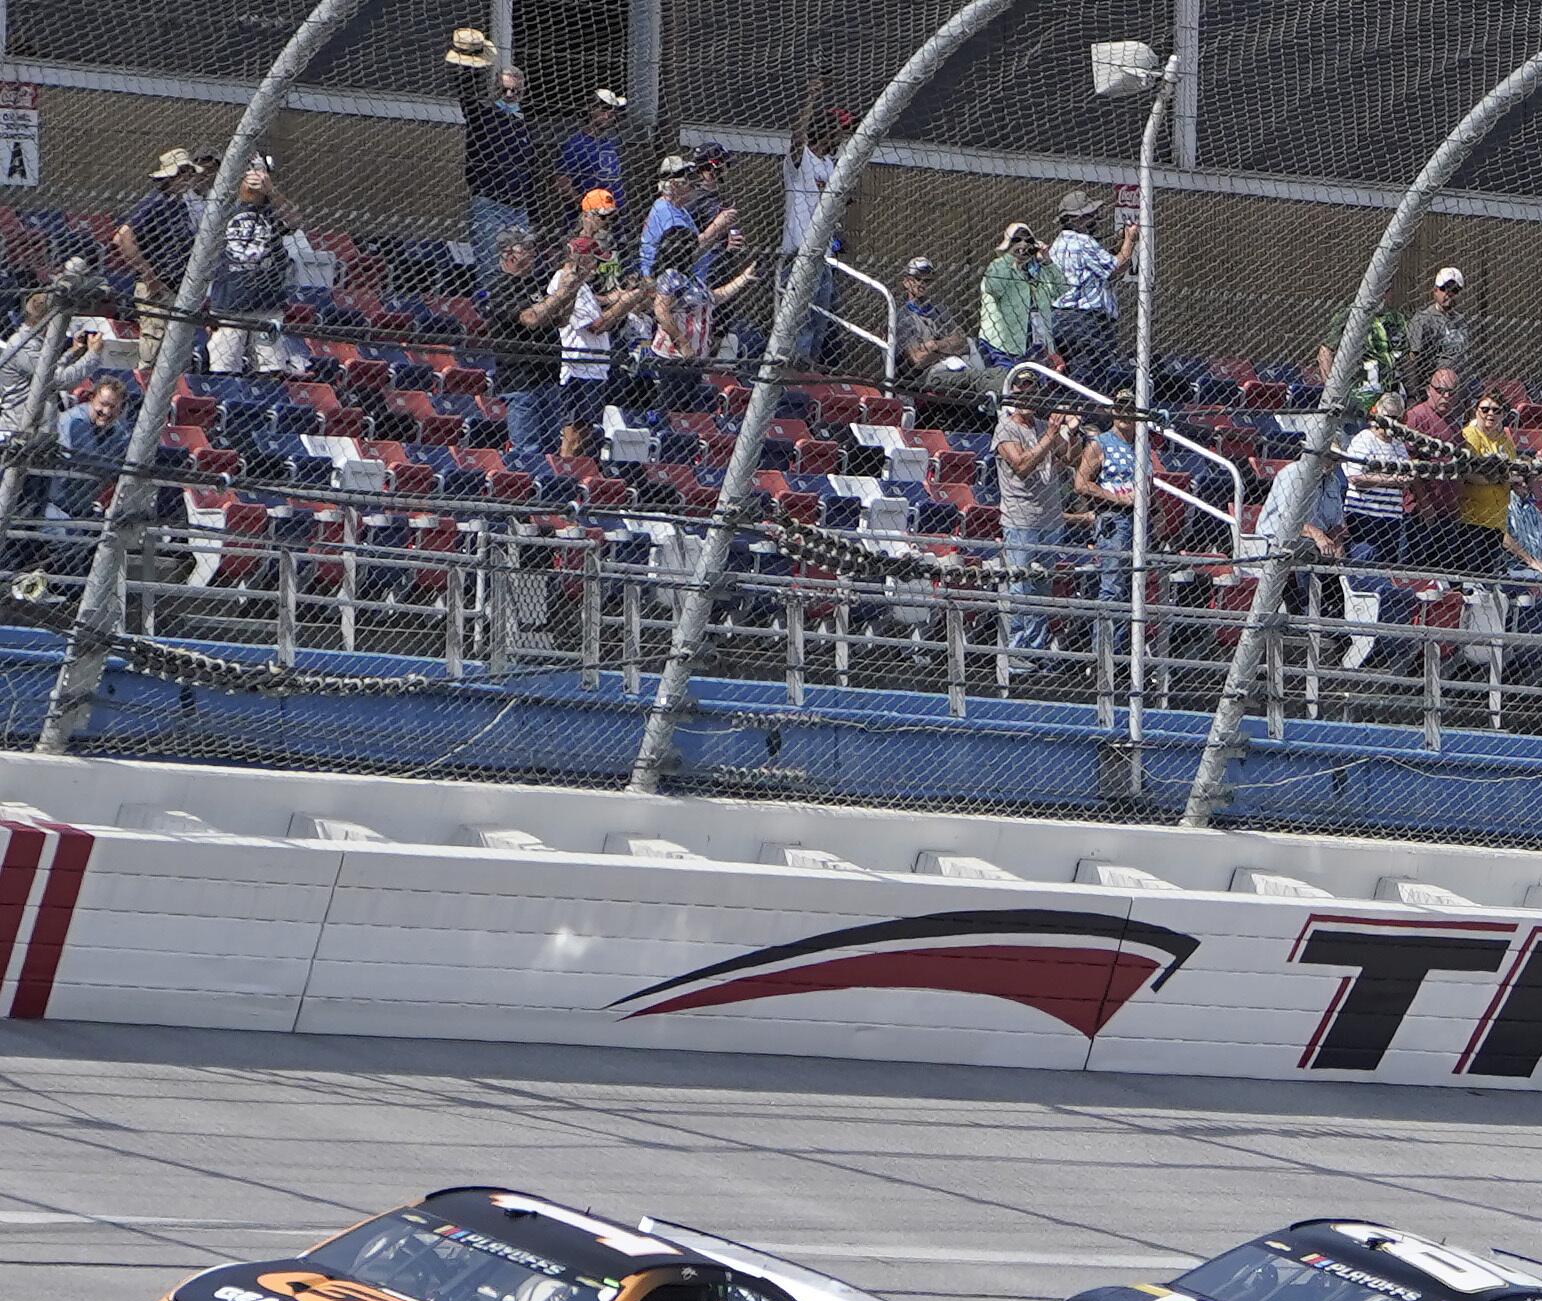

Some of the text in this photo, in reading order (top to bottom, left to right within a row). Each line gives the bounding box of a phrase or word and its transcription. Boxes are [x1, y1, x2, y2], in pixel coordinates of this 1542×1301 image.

[8, 141, 27, 180] A
[459, 1233, 566, 1275] PLAYOFFS
[1324, 1262, 1422, 1301] PLAYOFFS
